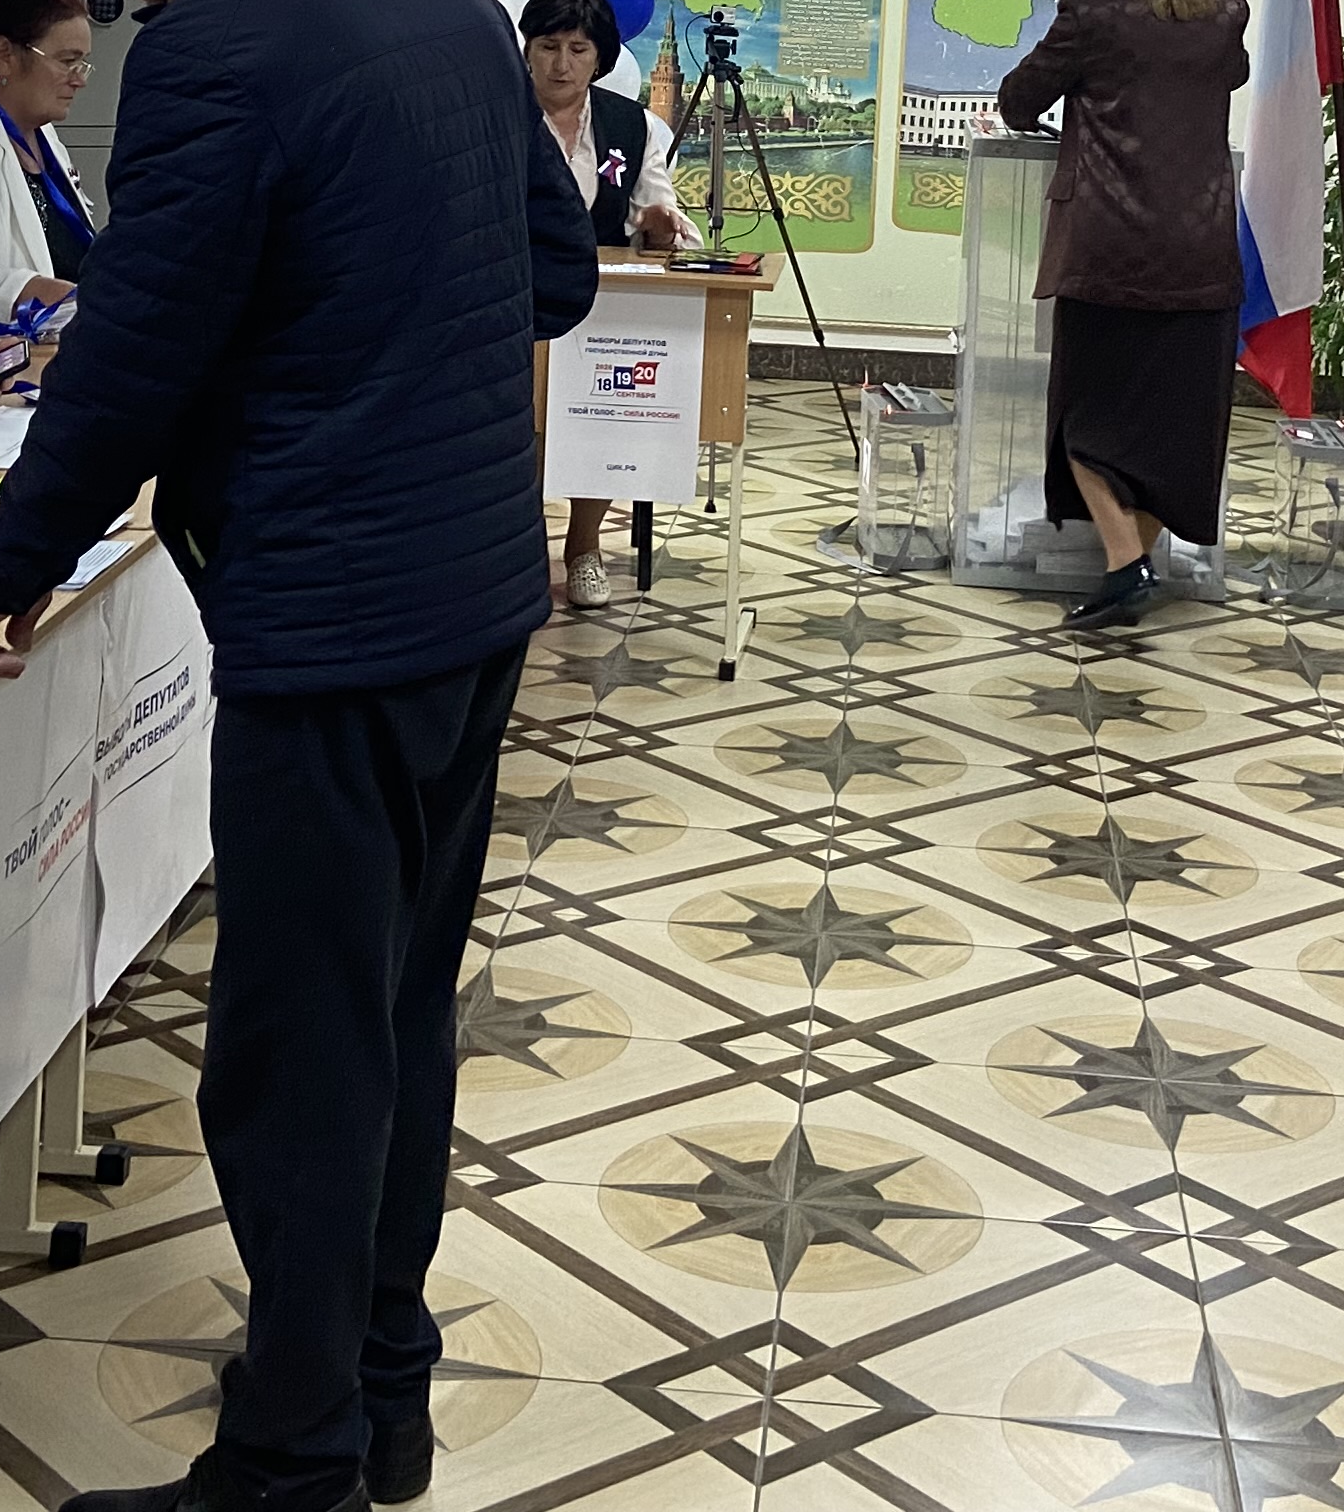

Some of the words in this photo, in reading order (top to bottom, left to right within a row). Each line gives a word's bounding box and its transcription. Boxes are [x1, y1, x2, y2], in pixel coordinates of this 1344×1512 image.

[597, 377, 612, 391] 18
[615, 371, 632, 385] 19
[634, 366, 655, 380] 20
[133, 665, 190, 729] ДЕПУТАТОВ
[4, 825, 38, 880] ТВОЙ
